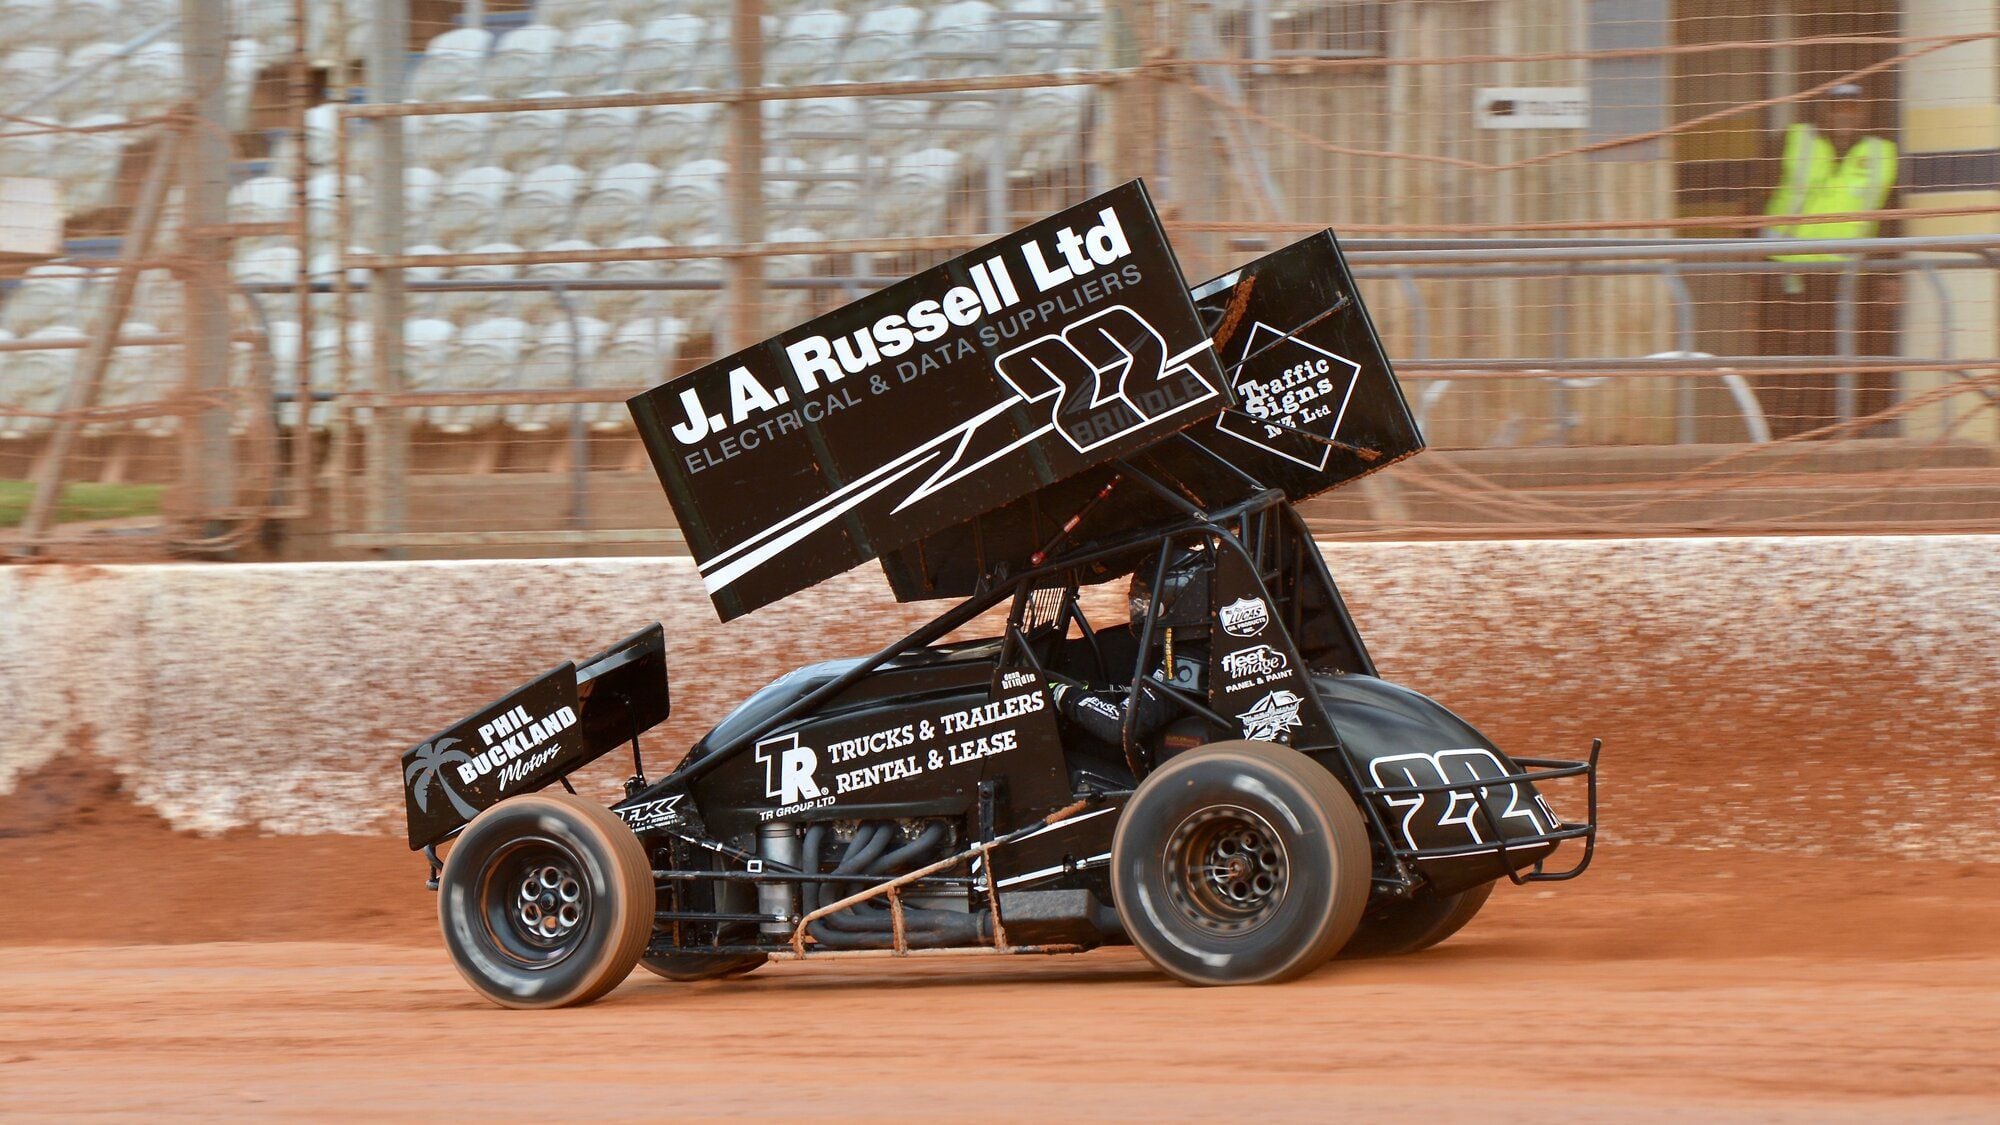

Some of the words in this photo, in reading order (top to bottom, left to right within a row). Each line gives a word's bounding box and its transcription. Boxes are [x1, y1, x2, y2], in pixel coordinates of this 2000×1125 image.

[671, 367, 789, 446] J.A.
[785, 257, 1021, 394] Russell
[1021, 207, 1132, 293] Ltd
[684, 391, 862, 474] ELECTRICAL
[868, 375, 890, 394] &
[896, 338, 976, 381] DATA
[981, 264, 1143, 349] SUPPLIERS
[994, 305, 1219, 454] 22
[1237, 358, 1330, 403] Traffic
[1070, 375, 1203, 446] BRINDLE
[1245, 377, 1334, 423] Signs
[1264, 415, 1297, 439] NZ
[1300, 404, 1331, 424] Ltd
[1228, 607, 1262, 624] LUCAS
[1237, 616, 1266, 629] PRODUCTS
[1001, 673, 1036, 690] brindle
[1221, 649, 1266, 672] fleet
[1225, 680, 1256, 693] PANEL
[1256, 677, 1265, 685] &
[1265, 669, 1293, 682] PAINT
[1230, 657, 1280, 679] image
[456, 705, 578, 785] BUCKLAND
[477, 704, 533, 746] PHIL
[827, 724, 914, 764] TRUCKS
[918, 719, 935, 741] &
[941, 690, 1045, 735] TRAILERS
[497, 742, 561, 791] Motors
[755, 731, 821, 805] TR
[835, 756, 922, 794] RENTAL
[927, 749, 944, 770] &
[949, 730, 1017, 766] LEASE
[759, 810, 774, 821] TR
[775, 800, 814, 818] GROUP
[816, 795, 836, 809] LTD
